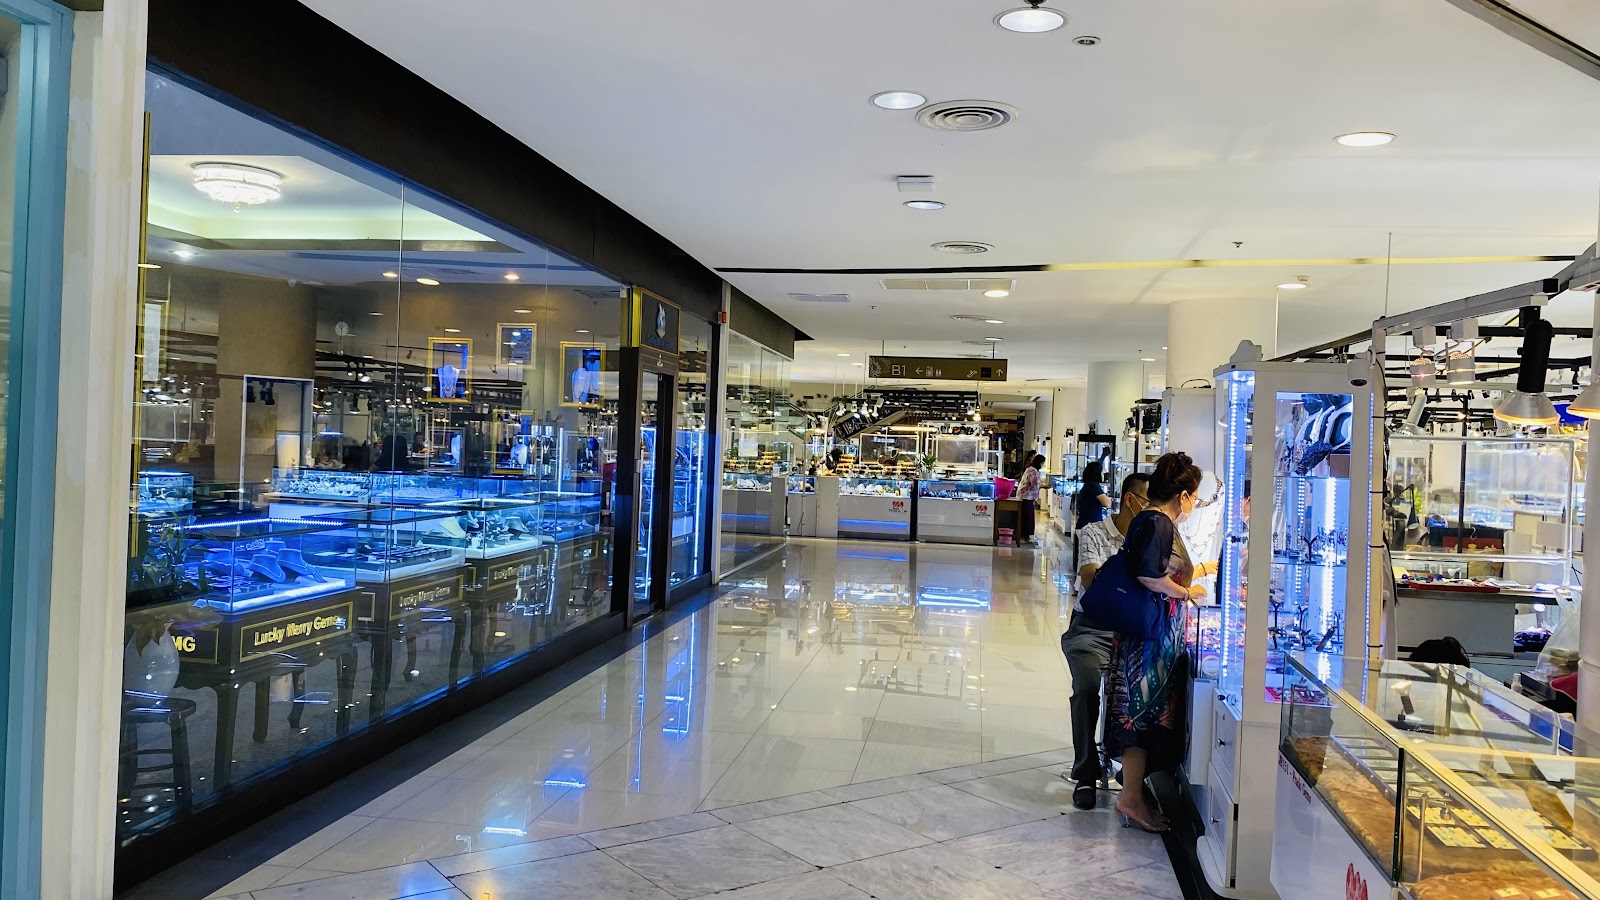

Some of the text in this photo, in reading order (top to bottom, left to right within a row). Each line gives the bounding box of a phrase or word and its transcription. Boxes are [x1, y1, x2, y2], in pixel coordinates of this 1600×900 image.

[891, 364, 906, 376] B1
[399, 586, 452, 608] Lucky Merry Gems
[254, 615, 339, 646] Lucky Merry Gems
